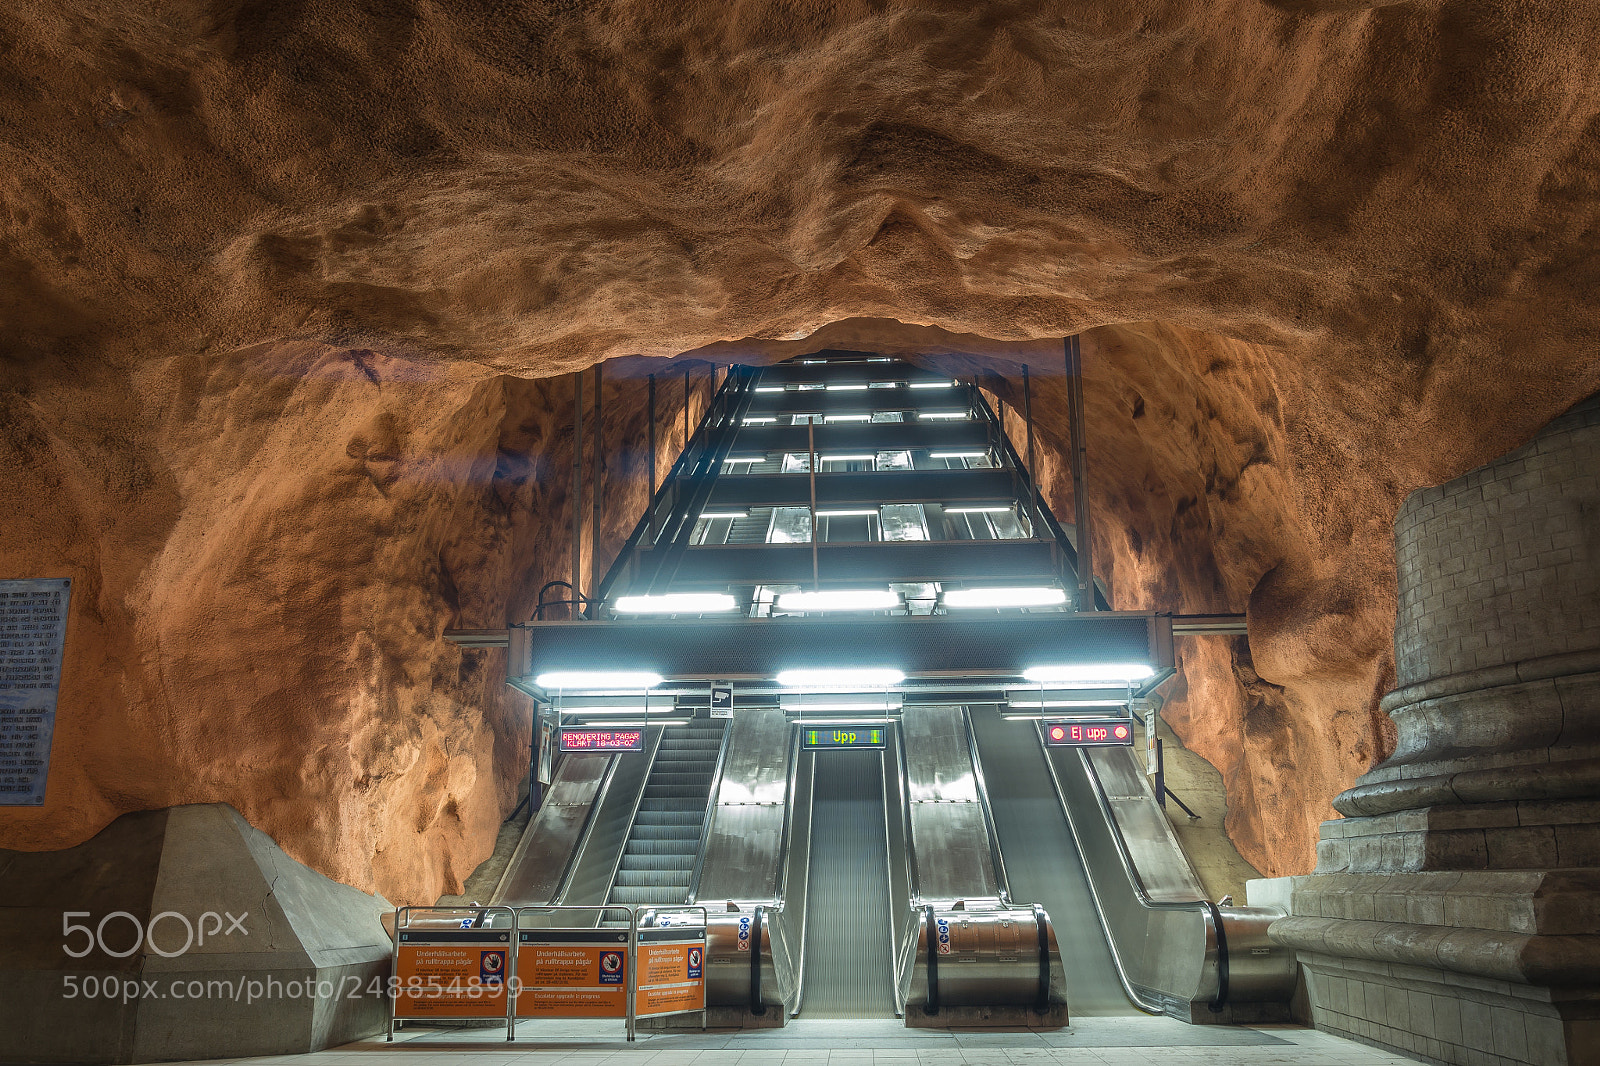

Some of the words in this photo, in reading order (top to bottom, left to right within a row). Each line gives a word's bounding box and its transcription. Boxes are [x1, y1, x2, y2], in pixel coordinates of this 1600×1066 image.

[562, 733, 611, 741] RENOVERING
[833, 730, 856, 744] Upp
[1071, 726, 1082, 741] Ej
[1086, 728, 1107, 741] upp
[567, 740, 591, 748] KLART
[596, 739, 635, 747] 18-03-07
